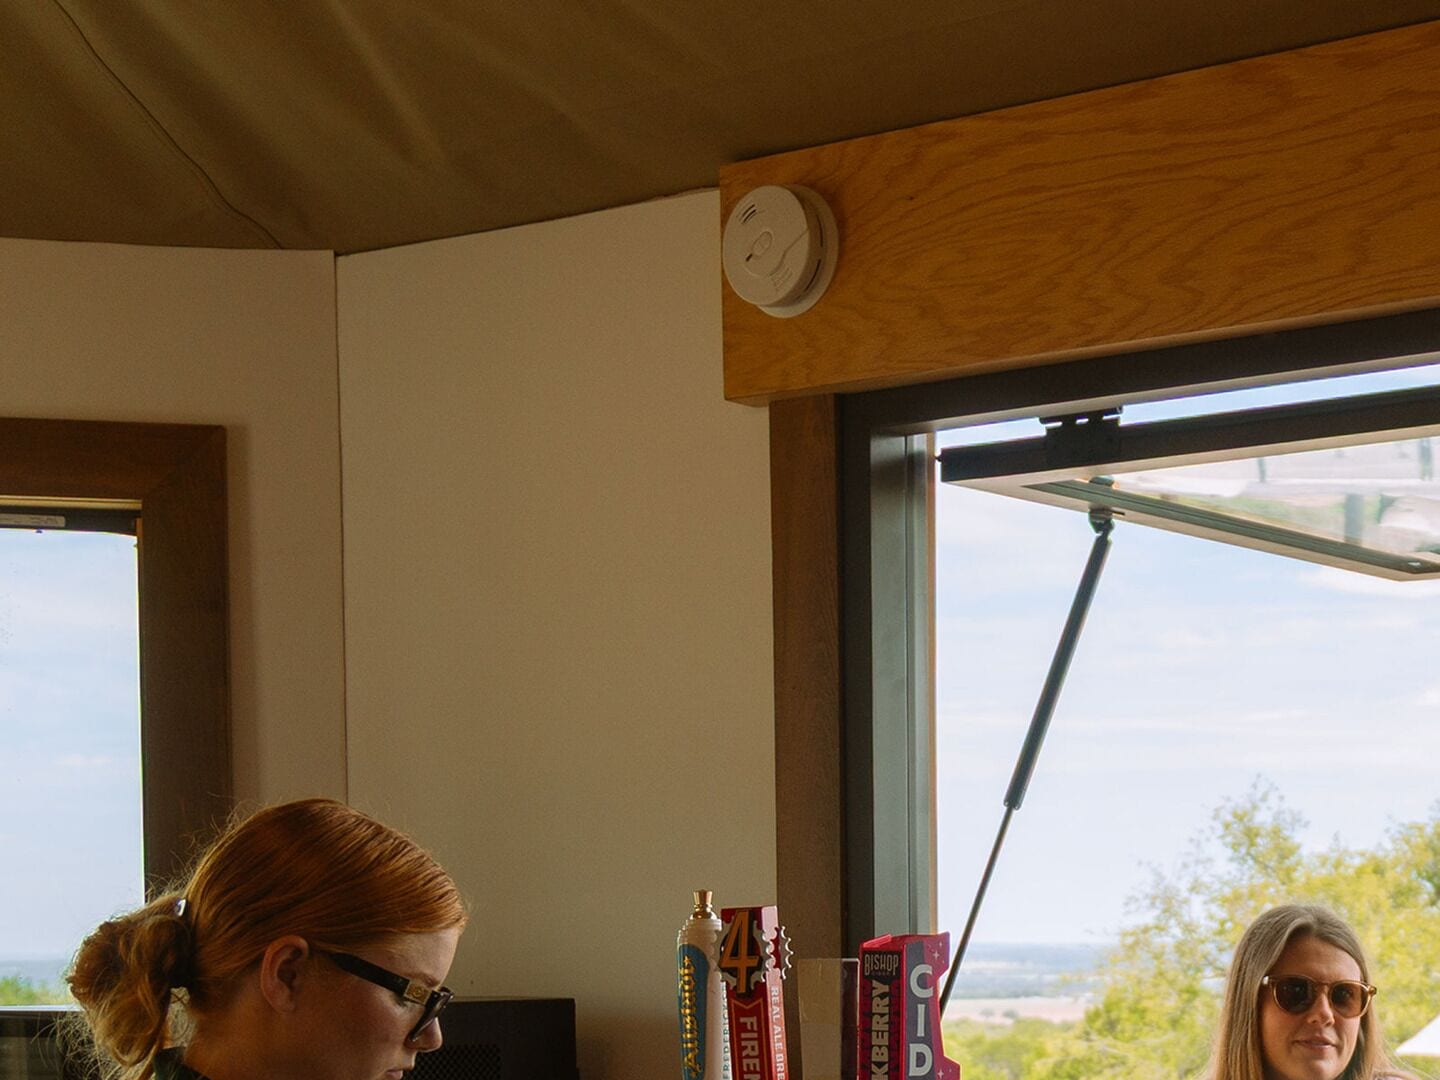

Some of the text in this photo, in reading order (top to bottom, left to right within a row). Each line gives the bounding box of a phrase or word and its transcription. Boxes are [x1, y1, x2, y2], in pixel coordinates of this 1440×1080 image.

[720, 909, 760, 993] 4
[864, 953, 899, 976] BISHOP
[771, 986, 780, 1023] REAL
[773, 1024, 783, 1050] ALE
